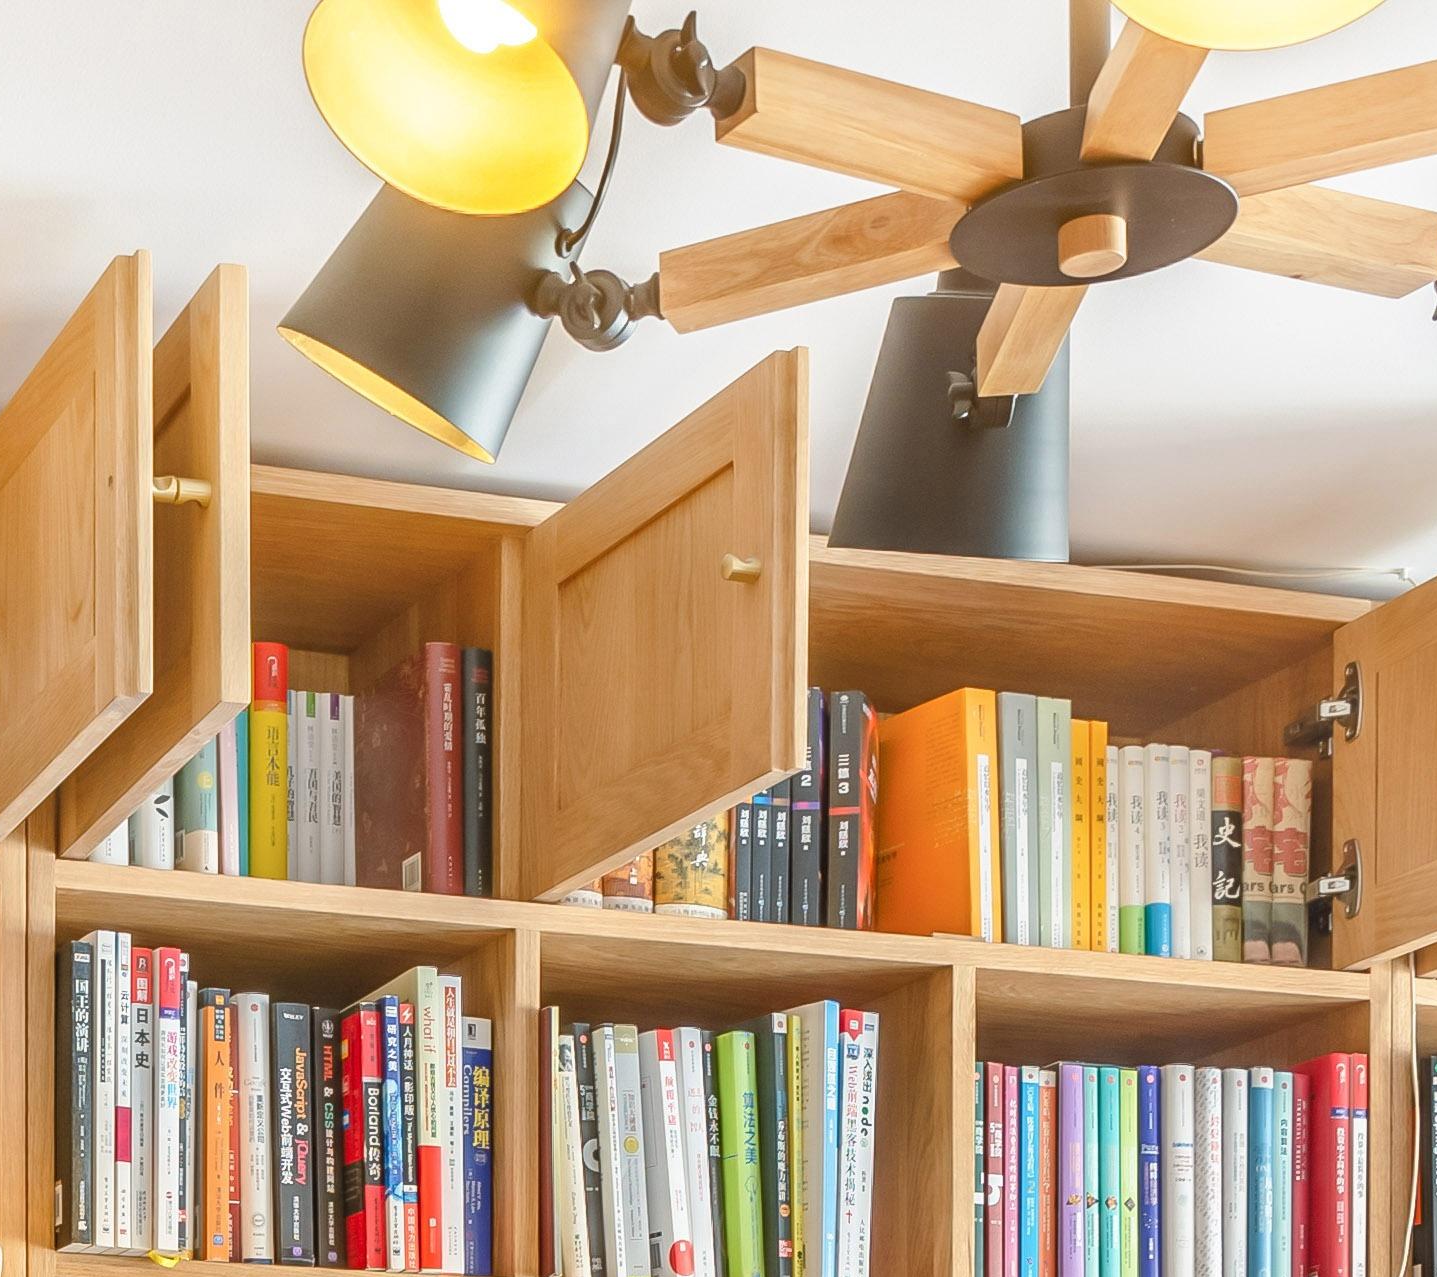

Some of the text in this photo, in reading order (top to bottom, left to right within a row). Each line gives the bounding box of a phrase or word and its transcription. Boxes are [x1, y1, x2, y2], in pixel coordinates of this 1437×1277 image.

[475, 693, 486, 745] 百年孤独
[75, 979, 89, 1052] 国王的演讲
[134, 1009, 149, 1069] 日本史
[387, 1024, 397, 1072] 研究之美
[323, 1045, 332, 1081] HTML
[279, 1067, 294, 1185] 交互式Web前端开发
[295, 1047, 308, 1185] JavaScript & jQuery
[367, 1087, 382, 1180] Borland传奇
[473, 1065, 489, 1149] 编译原理
[742, 1091, 757, 1165] 算法之美
